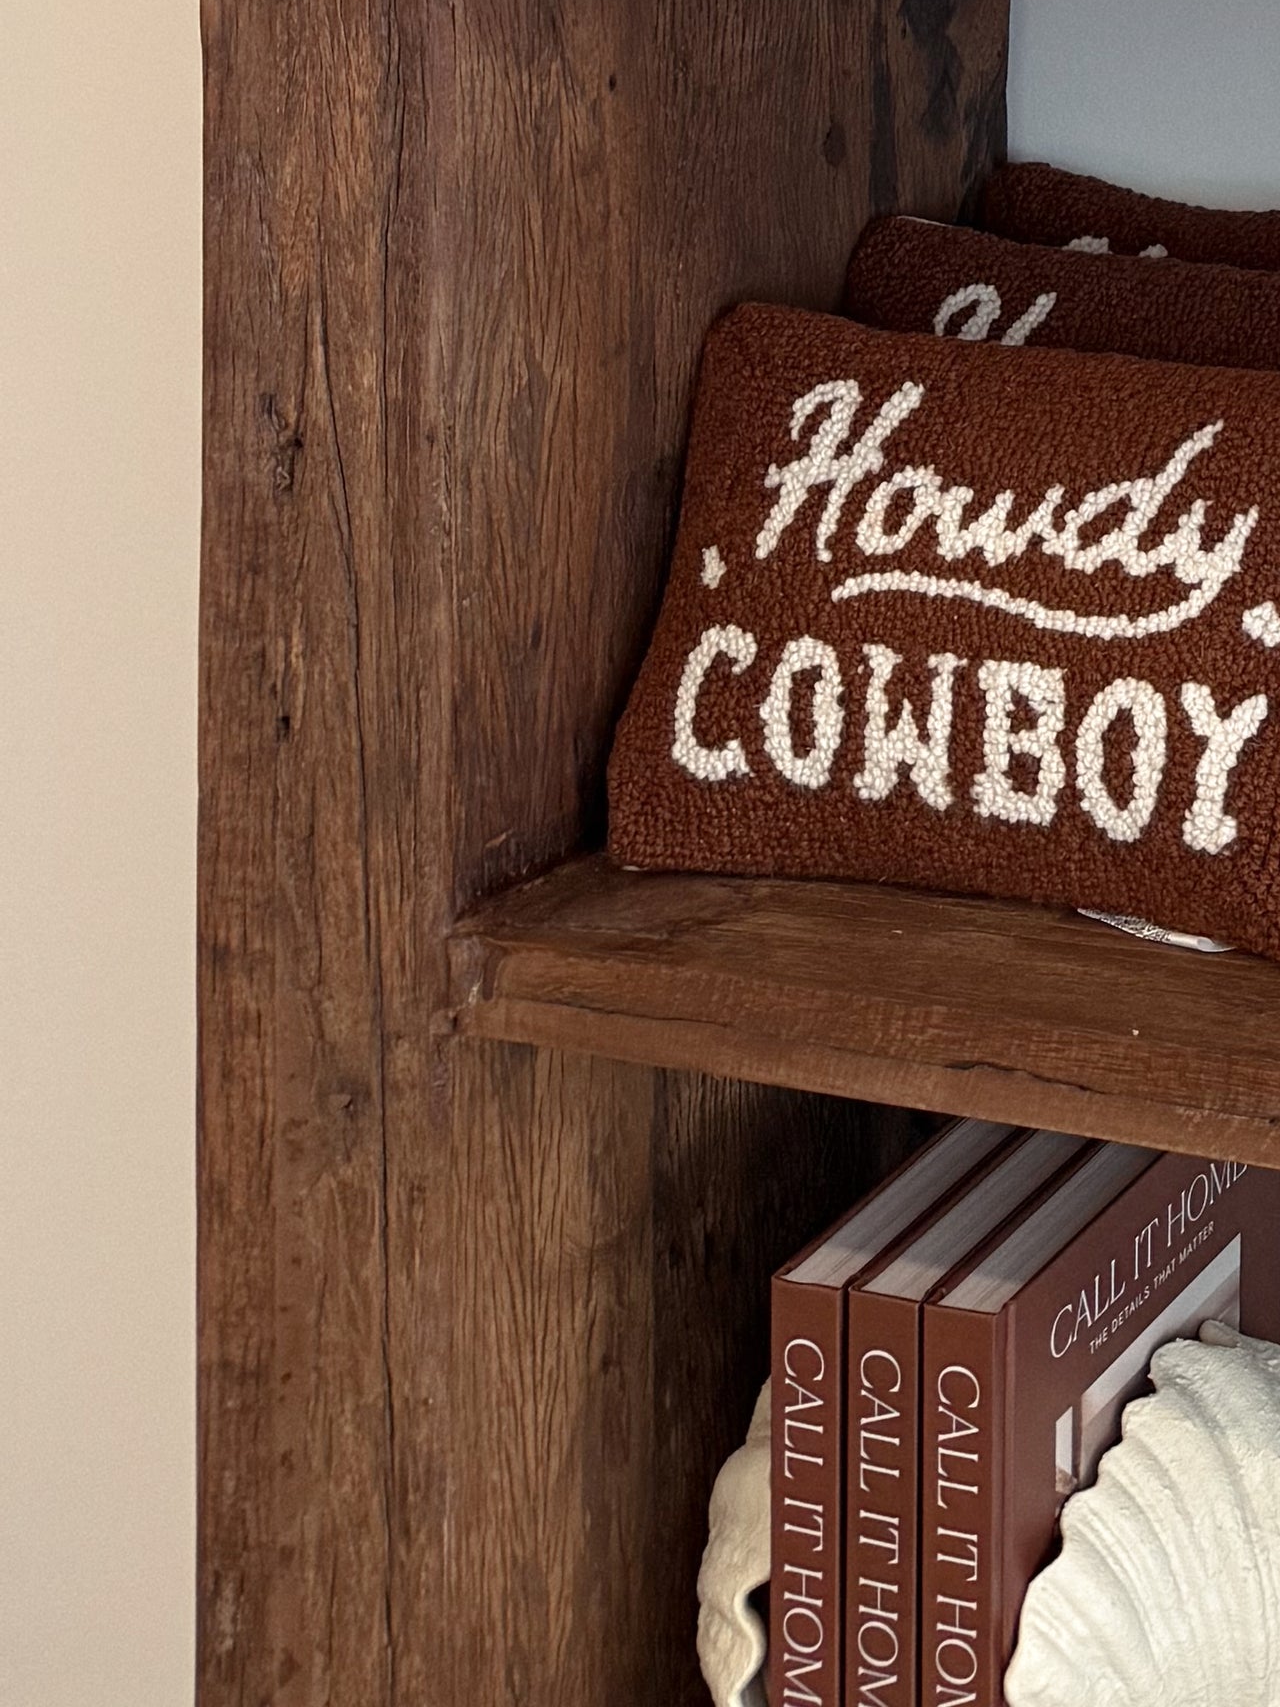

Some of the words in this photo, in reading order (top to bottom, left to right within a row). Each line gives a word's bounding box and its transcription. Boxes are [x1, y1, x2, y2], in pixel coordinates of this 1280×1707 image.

[755, 380, 1260, 640] Howdy
[670, 624, 1268, 855] COWBOY
[1050, 1259, 1126, 1358] CALL
[1133, 1217, 1160, 1280] IT
[1089, 1328, 1109, 1355] THE
[1111, 1285, 1150, 1334] DETAILS
[1153, 1258, 1176, 1290] THAT
[1178, 1220, 1215, 1264] MATTER
[784, 1338, 825, 1480] CALL
[860, 1349, 901, 1492] CALL
[937, 1365, 980, 1509] CALL
[784, 1497, 824, 1552] IT
[859, 1509, 900, 1565] IT
[937, 1526, 978, 1582] IT
[783, 1563, 823, 1707] HOM
[857, 1576, 899, 1707] HOM
